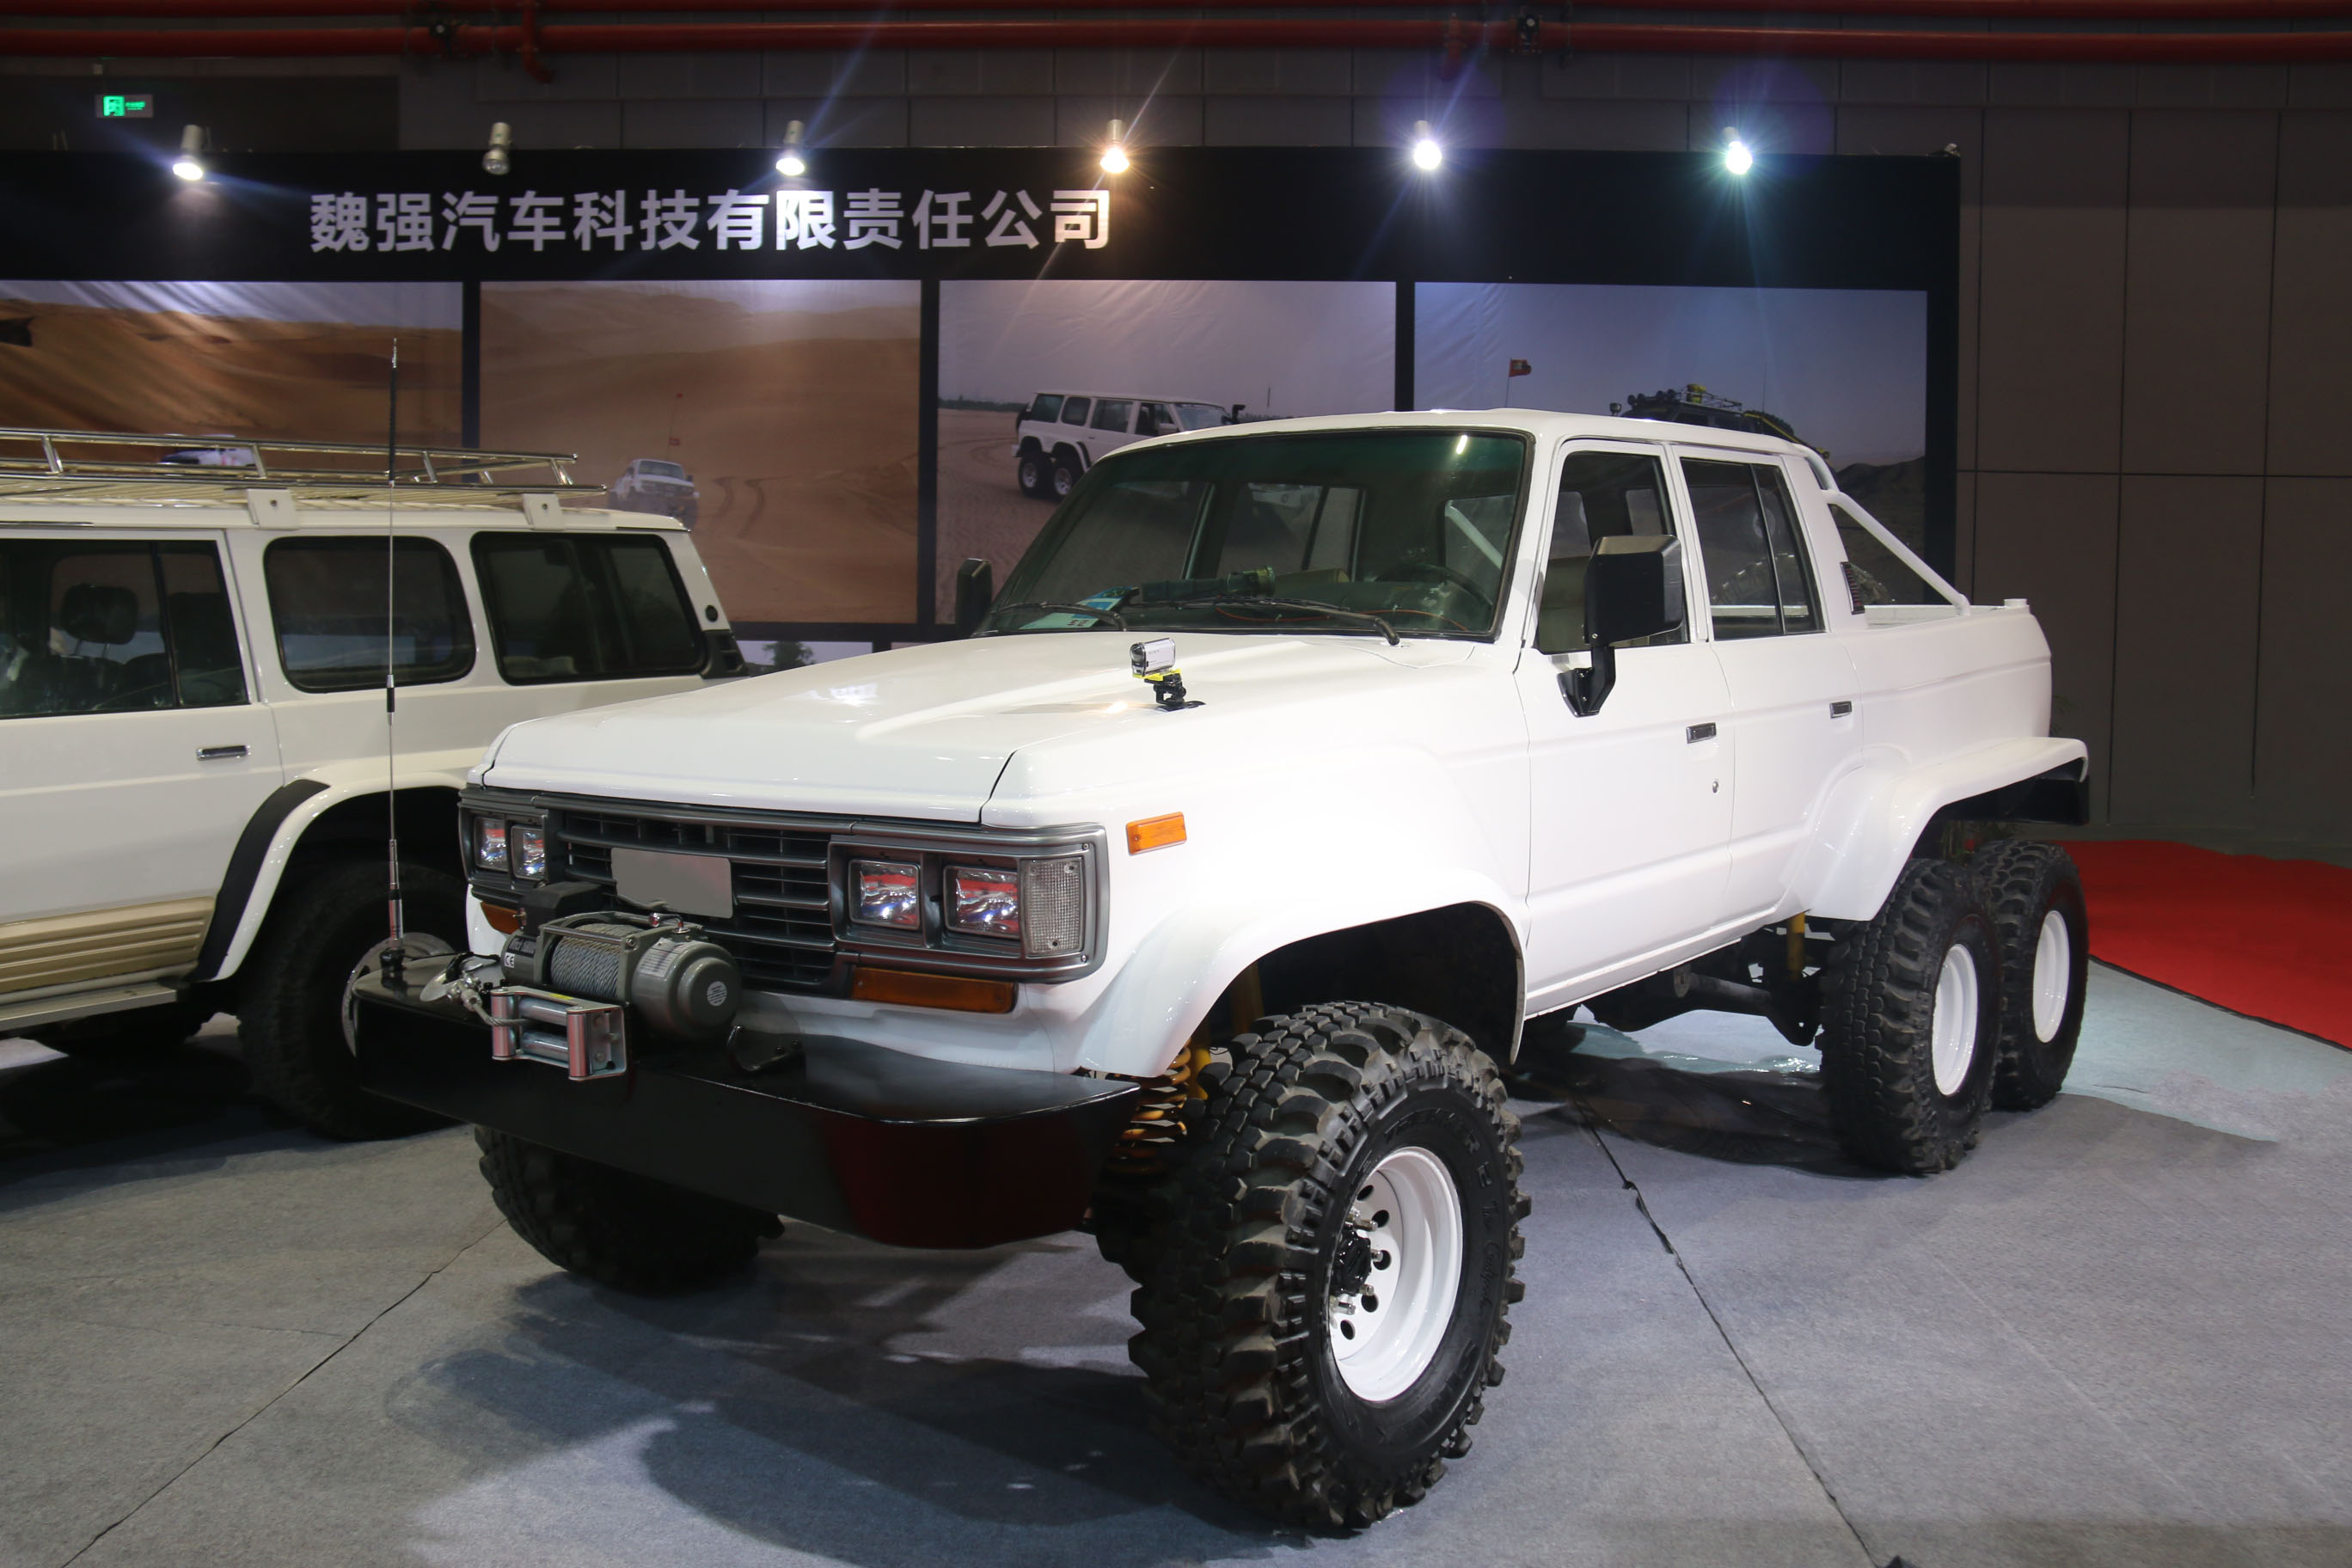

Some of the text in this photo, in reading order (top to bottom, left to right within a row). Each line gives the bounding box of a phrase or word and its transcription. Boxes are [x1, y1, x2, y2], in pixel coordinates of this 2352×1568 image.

[309, 188, 1111, 252] 魏强汽车科技有限责任公司
